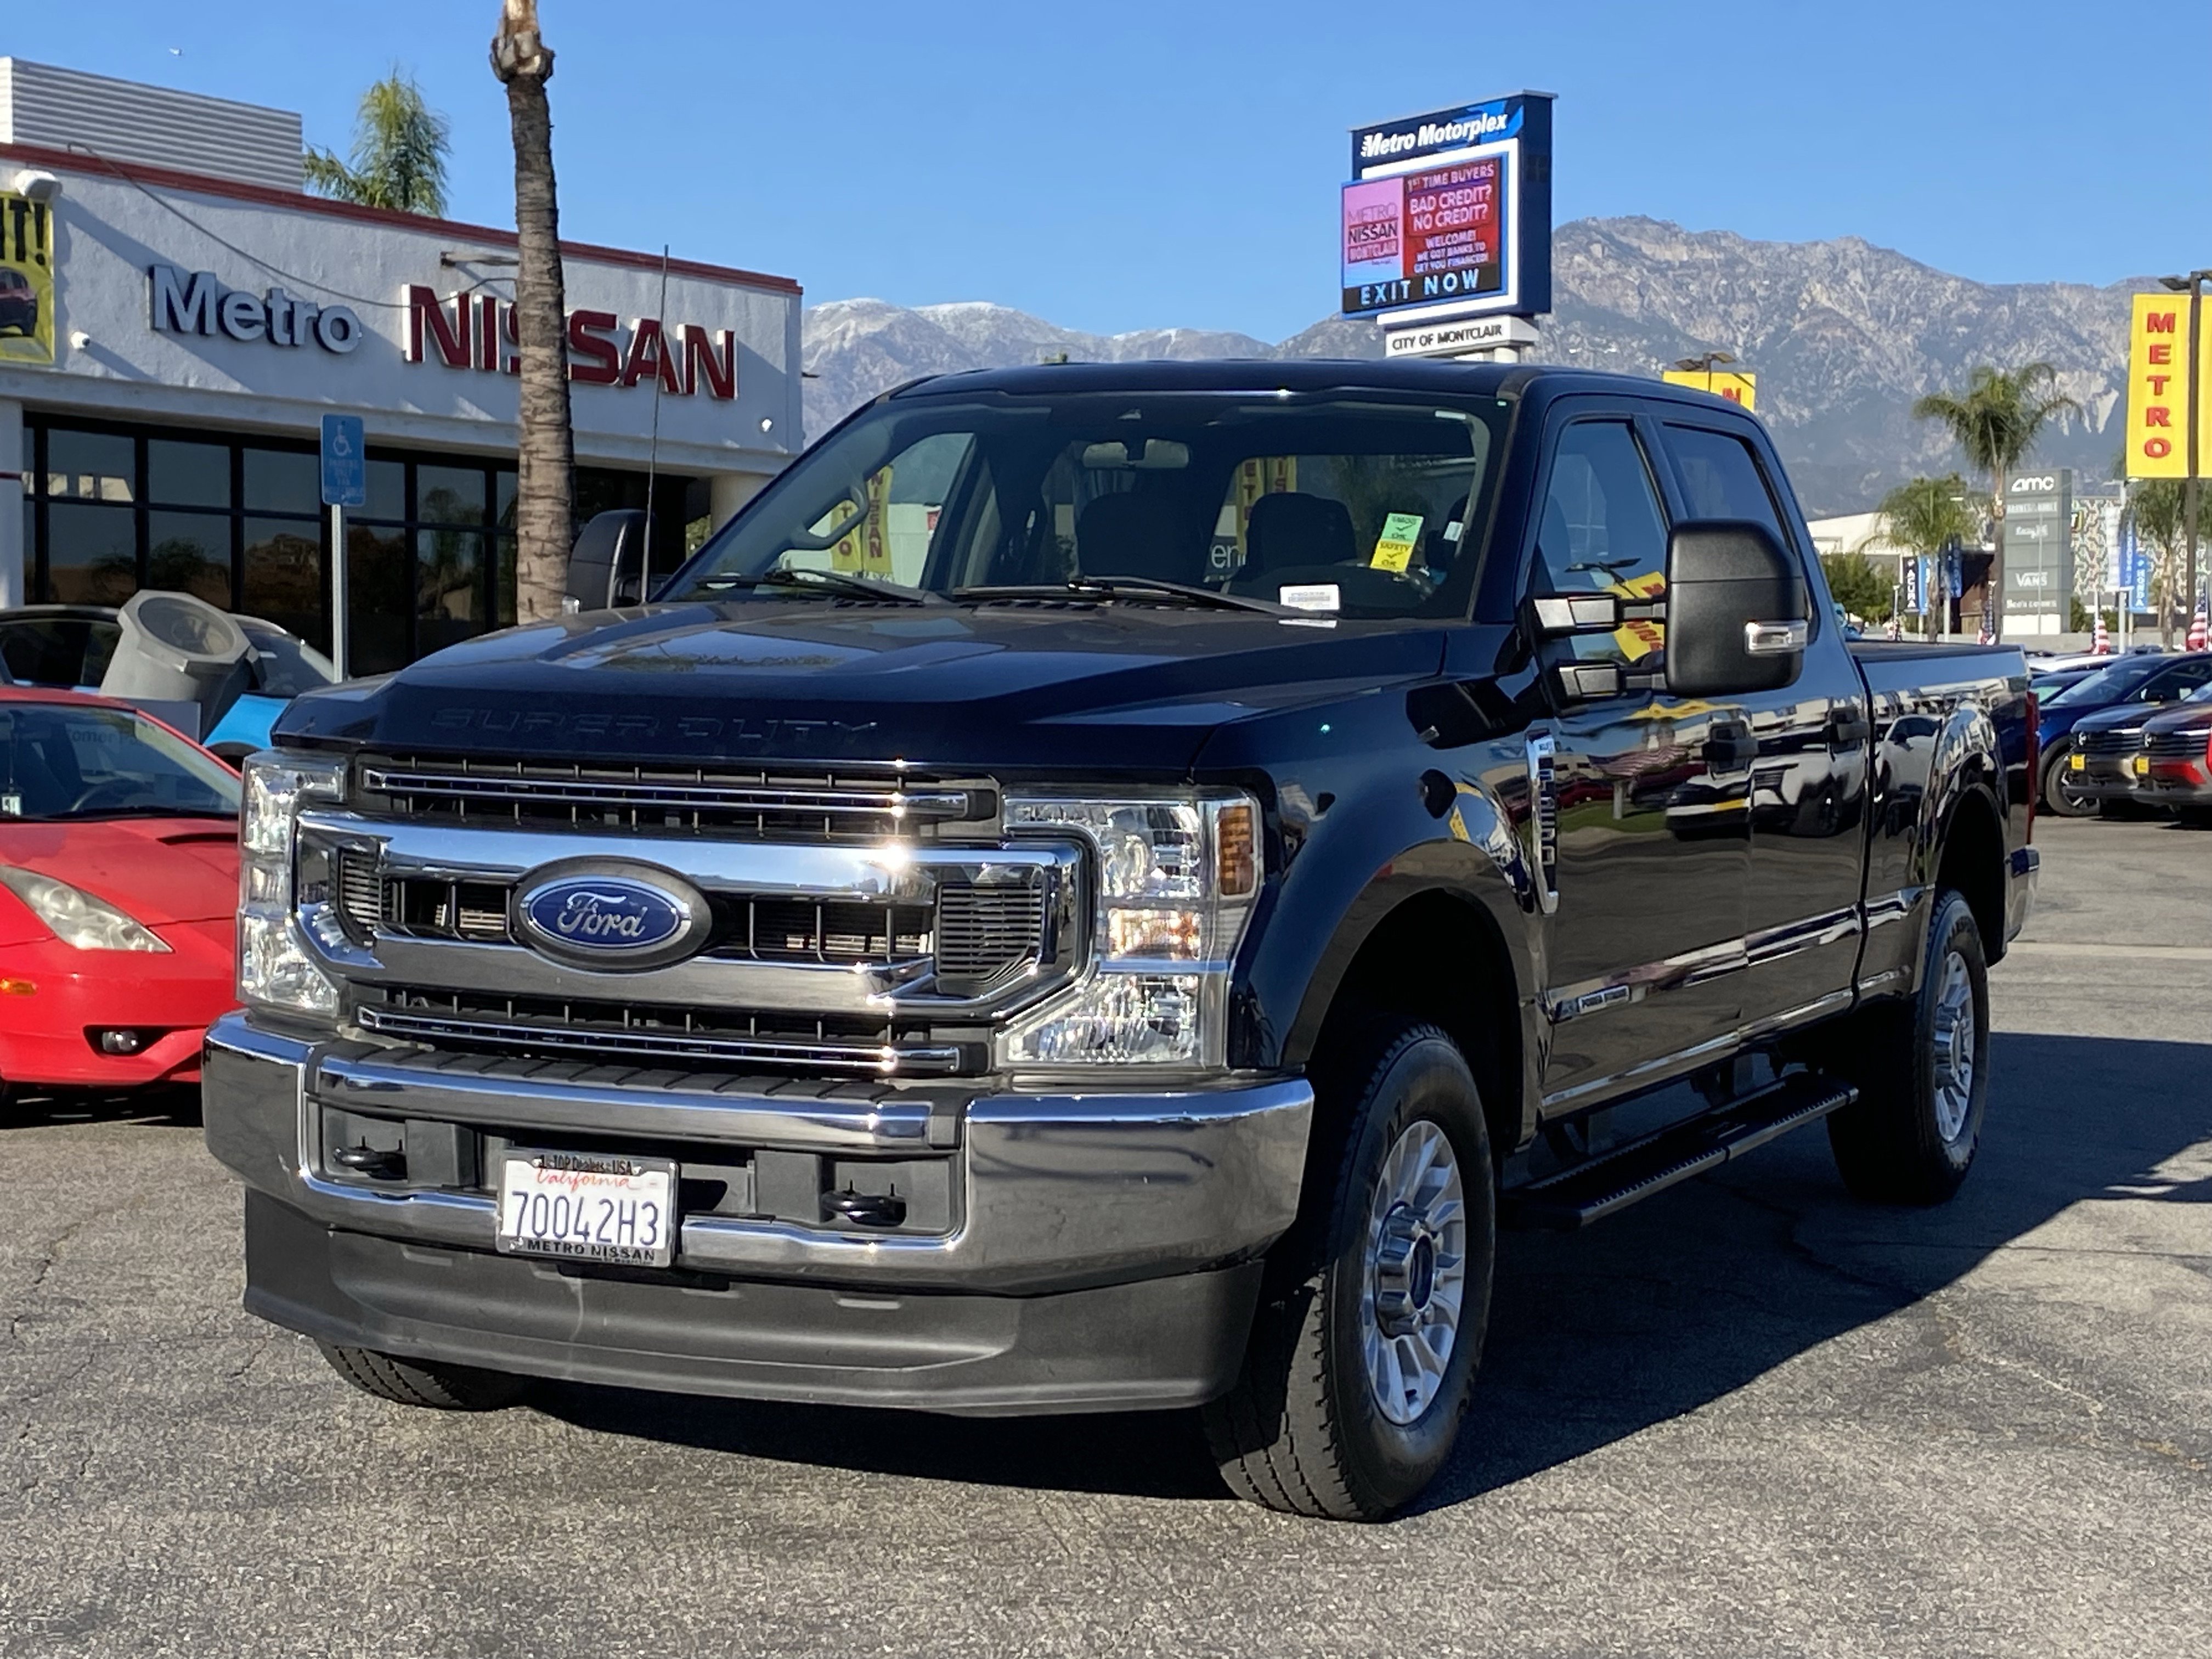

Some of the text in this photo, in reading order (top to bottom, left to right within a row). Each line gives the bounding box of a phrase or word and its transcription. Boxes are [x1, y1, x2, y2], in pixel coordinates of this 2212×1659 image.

[1361, 112, 1508, 157] Metro Motorplex
[1423, 172, 1449, 189] TIME
[1451, 164, 1494, 184] BUYERS
[1347, 202, 1397, 224] METRO
[1410, 184, 1492, 215] BAD CREDIT?
[1348, 222, 1398, 245] NISSAN
[1413, 203, 1488, 232] NO CREDIT?
[1360, 269, 1479, 306] EXIT NOW
[147, 263, 362, 354] Metro
[1392, 324, 1502, 351] CITY OF MONTCLAIR
[2143, 313, 2176, 458] METRO
[1907, 569, 1916, 608] ACURA
[2015, 572, 2049, 587] VANS
[2137, 569, 2146, 607] HONDA
[430, 707, 878, 744] SUPER DUTY
[556, 891, 648, 938] Ford
[535, 1167, 641, 1193] California
[511, 1190, 659, 1246] 70042H3
[527, 1239, 655, 1261] METRO NISSAN
